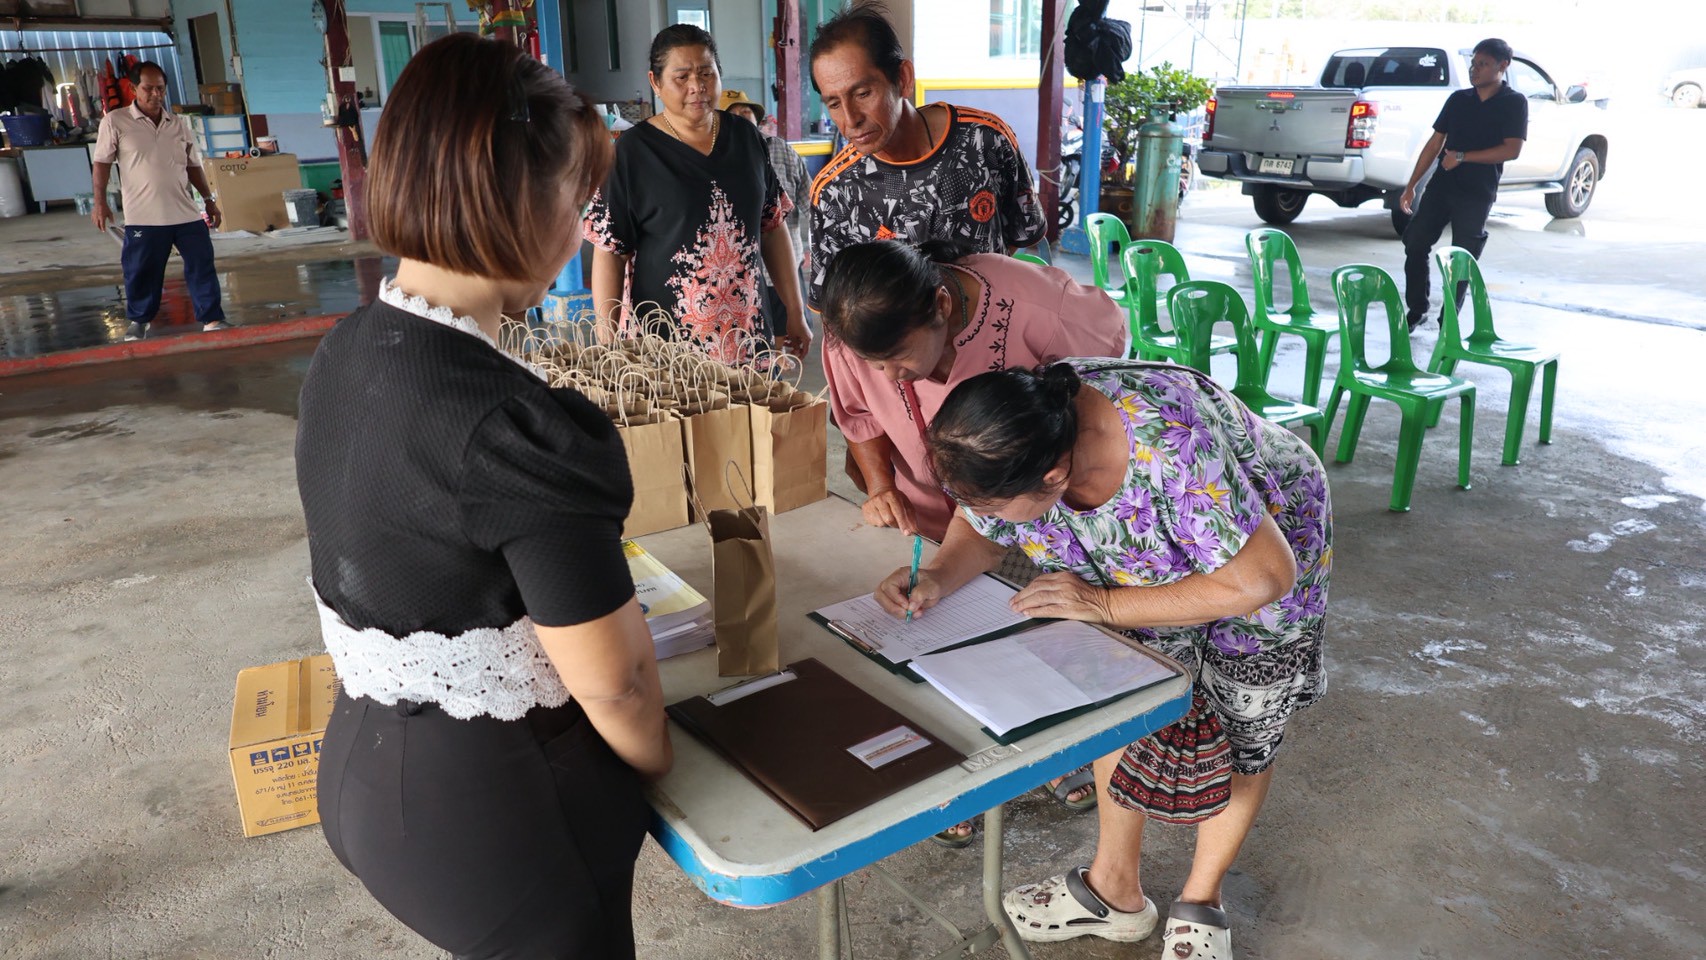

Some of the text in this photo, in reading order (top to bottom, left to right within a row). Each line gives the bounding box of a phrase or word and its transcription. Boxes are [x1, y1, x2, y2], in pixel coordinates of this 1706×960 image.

[220, 163, 247, 171] COTTO
[253, 765, 275, 775] บรรจุ
[277, 760, 294, 770] 220
